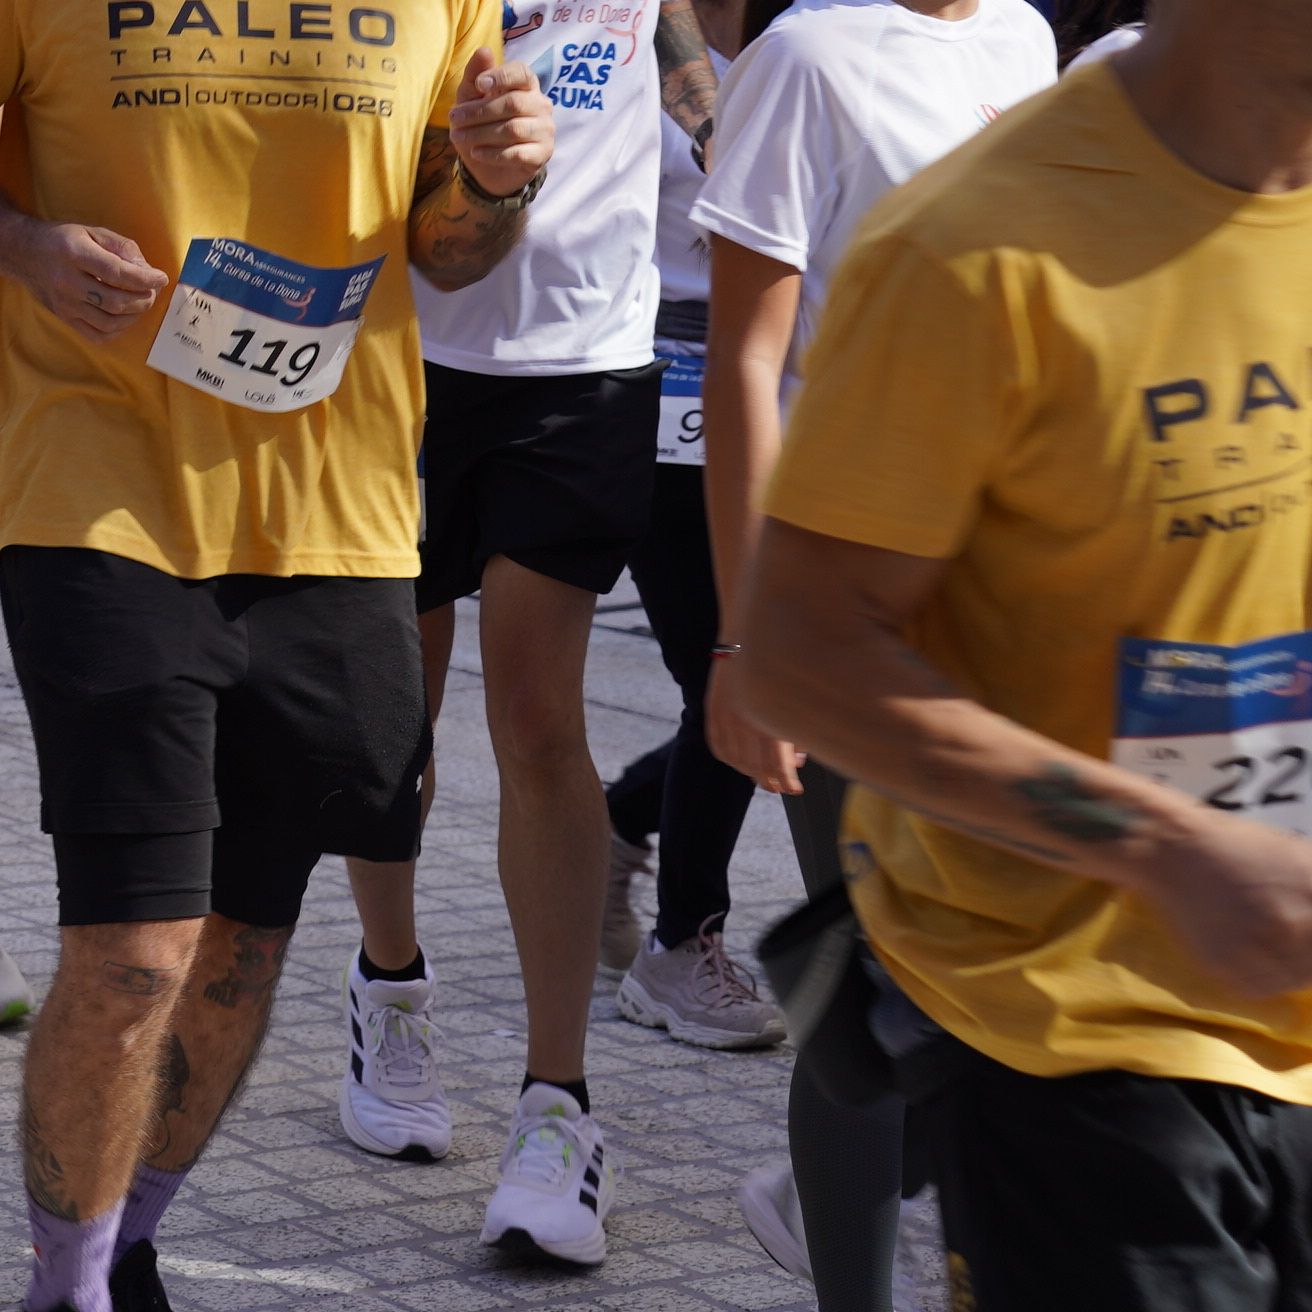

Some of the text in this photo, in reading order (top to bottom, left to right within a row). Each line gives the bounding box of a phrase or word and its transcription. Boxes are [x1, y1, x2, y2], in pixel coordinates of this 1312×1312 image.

[552, 3, 572, 23] de
[110, 47, 397, 74] TRAINING
[555, 61, 613, 87] PAS
[111, 89, 182, 110] AND
[195, 90, 319, 109] OUTDOOR
[212, 238, 255, 267] MORA
[216, 327, 322, 388] 119
[1144, 346, 1312, 442] PA
